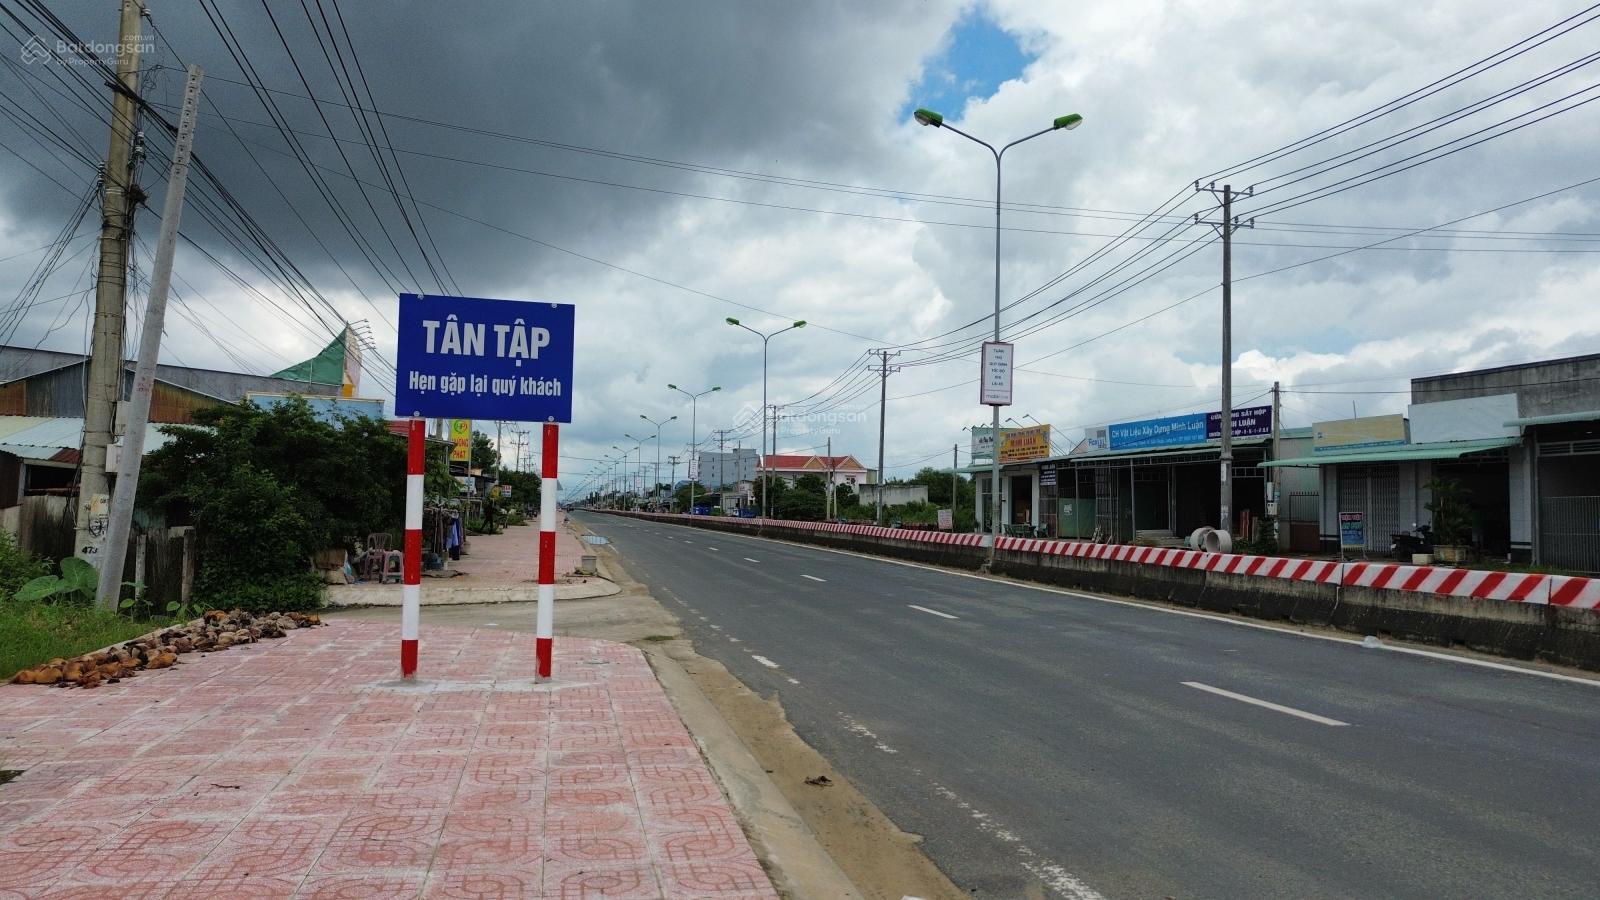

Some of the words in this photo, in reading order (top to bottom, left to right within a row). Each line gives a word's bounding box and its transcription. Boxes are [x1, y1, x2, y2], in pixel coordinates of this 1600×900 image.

[422, 313, 486, 357] TÂN
[493, 318, 551, 367] TẬP
[409, 370, 436, 395] Hẹn
[440, 371, 466, 396] gặp
[470, 373, 488, 397] lại
[492, 375, 518, 398] quý
[520, 376, 562, 397] khách
[1187, 420, 1204, 432] Luận
